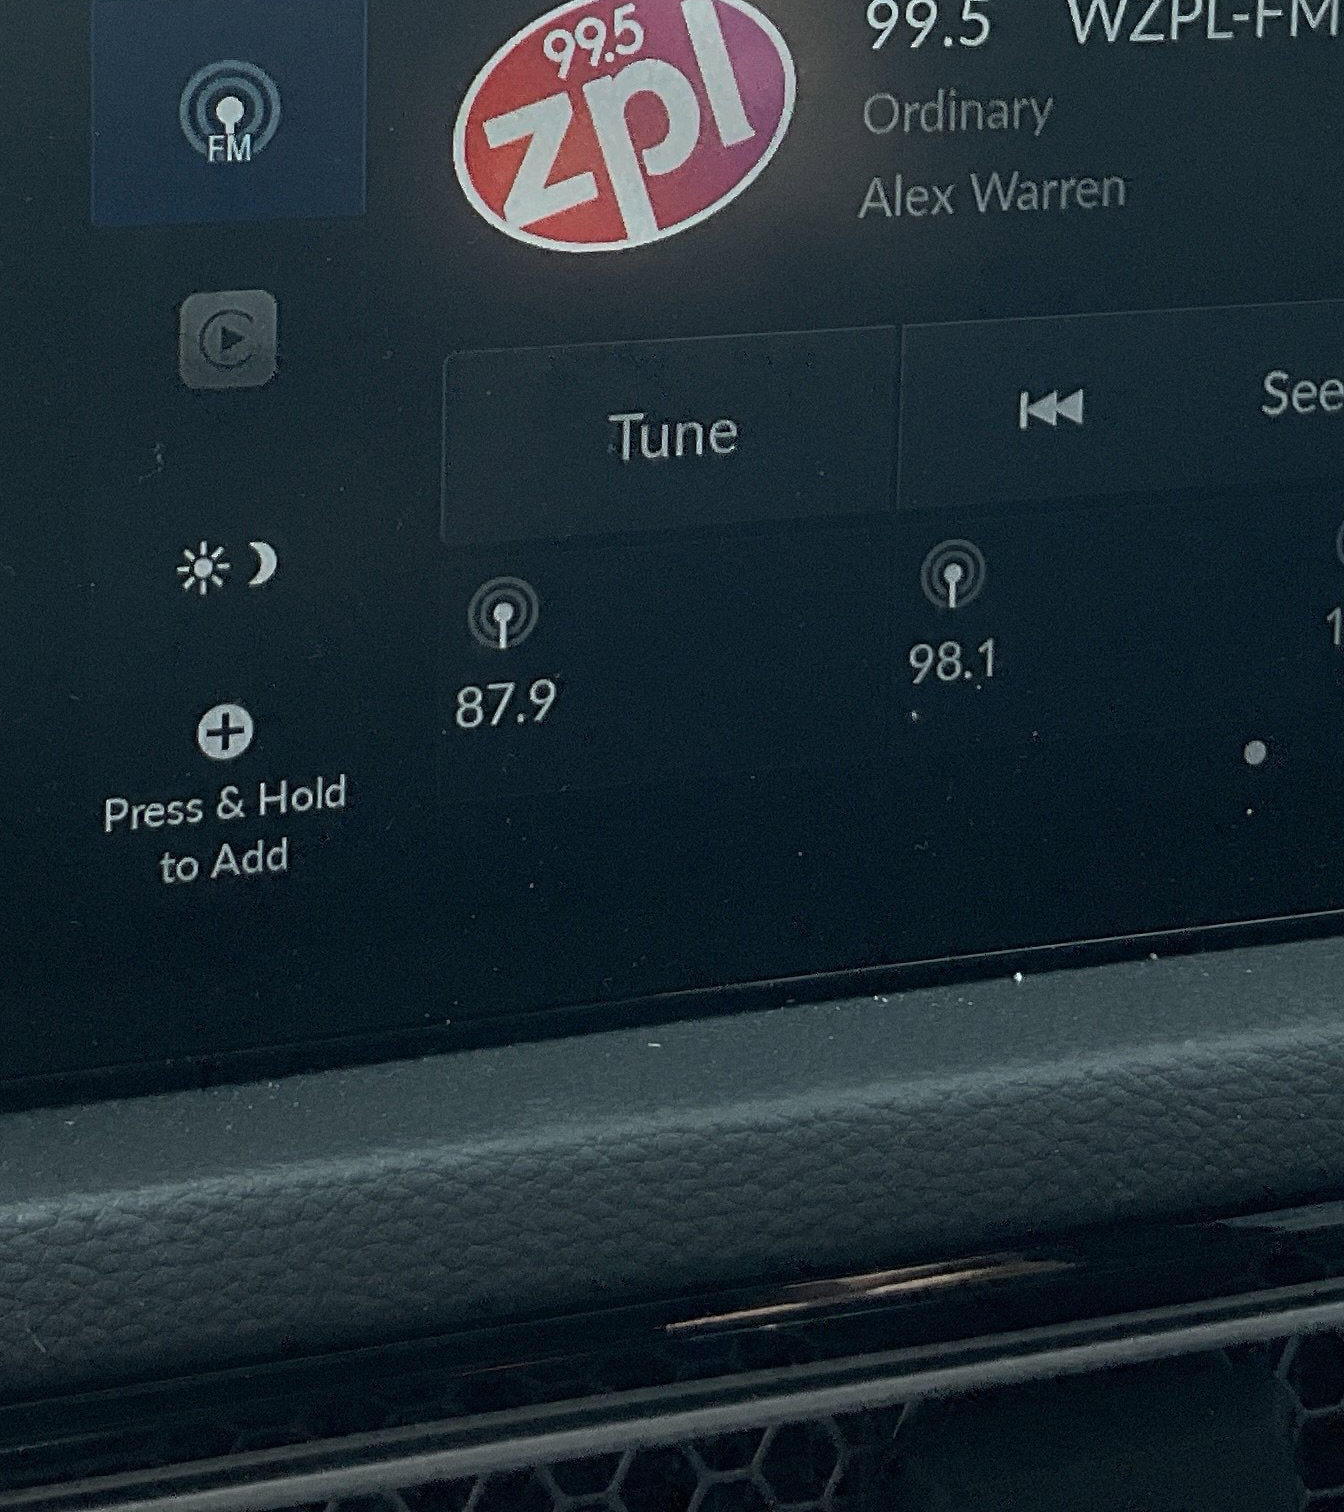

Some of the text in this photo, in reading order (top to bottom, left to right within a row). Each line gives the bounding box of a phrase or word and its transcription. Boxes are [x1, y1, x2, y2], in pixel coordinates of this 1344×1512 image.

[543, 2, 644, 81] 99.5
[862, 87, 1054, 137] Ordinary
[207, 133, 252, 163] FM
[857, 170, 1127, 219] Alex Warren
[607, 412, 738, 462] Tune
[909, 637, 995, 684] 98.1
[456, 677, 556, 729] 87.9
[104, 773, 346, 832] Press & Hold
[159, 836, 289, 883] to Add
